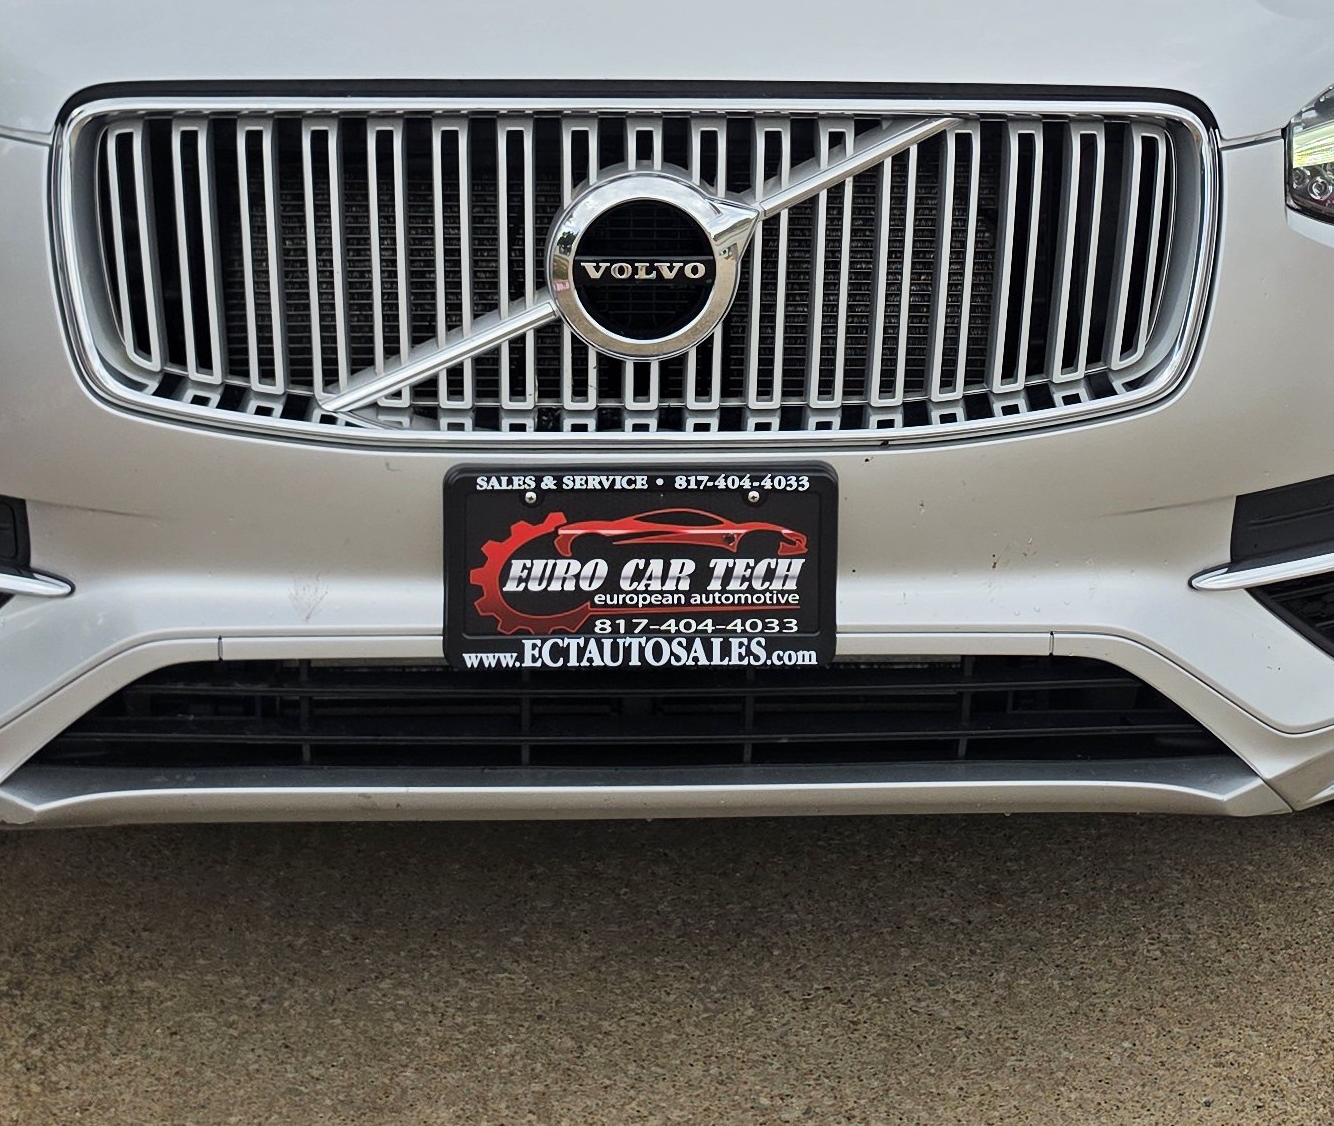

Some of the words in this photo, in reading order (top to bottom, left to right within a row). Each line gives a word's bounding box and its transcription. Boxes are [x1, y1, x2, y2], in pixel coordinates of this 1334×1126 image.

[580, 262, 706, 279] VOLVO
[476, 476, 536, 491] SALES
[541, 476, 557, 490] &
[562, 475, 648, 490] SERVICE
[674, 475, 810, 491] 817-404-4033
[503, 559, 609, 592] EURO
[619, 558, 696, 591] CAR
[707, 558, 806, 591] TECH
[593, 593, 685, 607] european
[690, 590, 800, 605] automotive
[593, 618, 799, 634] 817-404-4033
[463, 637, 818, 668] www.ECTAUTOSALES.com
